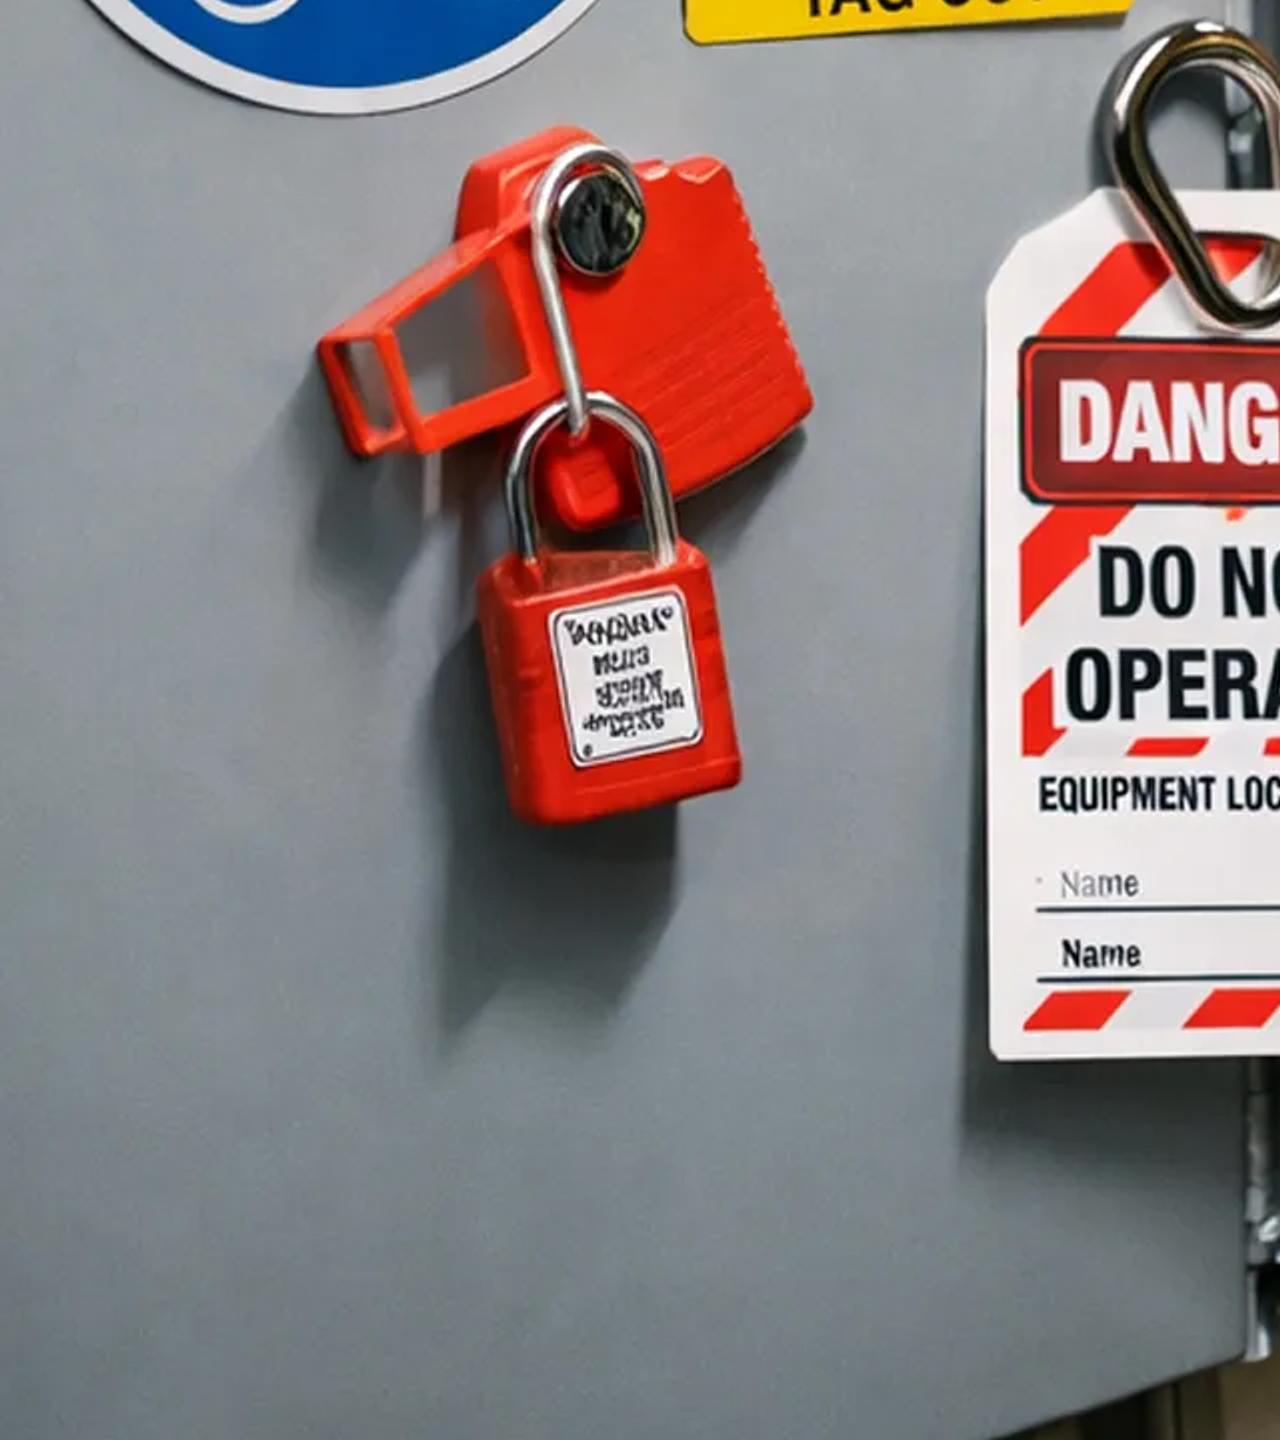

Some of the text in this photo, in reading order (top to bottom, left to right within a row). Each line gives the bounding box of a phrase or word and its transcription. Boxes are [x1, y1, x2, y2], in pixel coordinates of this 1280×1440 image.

[1098, 544, 1196, 619] DO
[1038, 775, 1216, 814] EQUIPMENT
[1060, 871, 1139, 899] Name
[1061, 939, 1142, 968] Name
